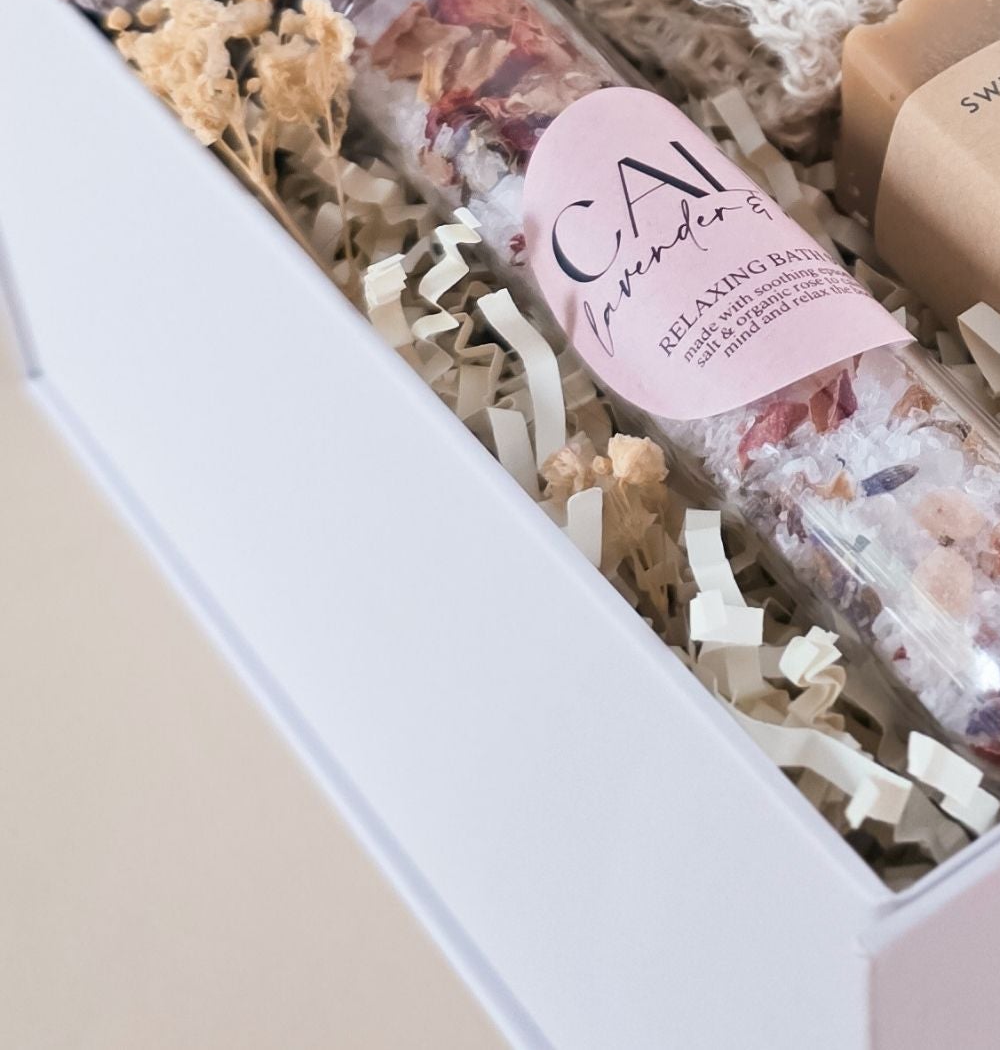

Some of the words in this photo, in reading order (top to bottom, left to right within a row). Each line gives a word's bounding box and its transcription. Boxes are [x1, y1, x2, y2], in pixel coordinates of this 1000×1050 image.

[583, 199, 743, 358] lavender
[659, 259, 767, 357] RELAXING
[684, 322, 719, 362] made
[719, 294, 754, 322] with
[754, 268, 819, 297] soothing
[698, 340, 721, 368] salt
[720, 327, 735, 340] &
[736, 288, 792, 327] organic
[793, 277, 825, 291] rose
[724, 320, 761, 358] mind
[761, 300, 792, 325] and
[792, 287, 831, 307] relax
[829, 284, 853, 295] the
